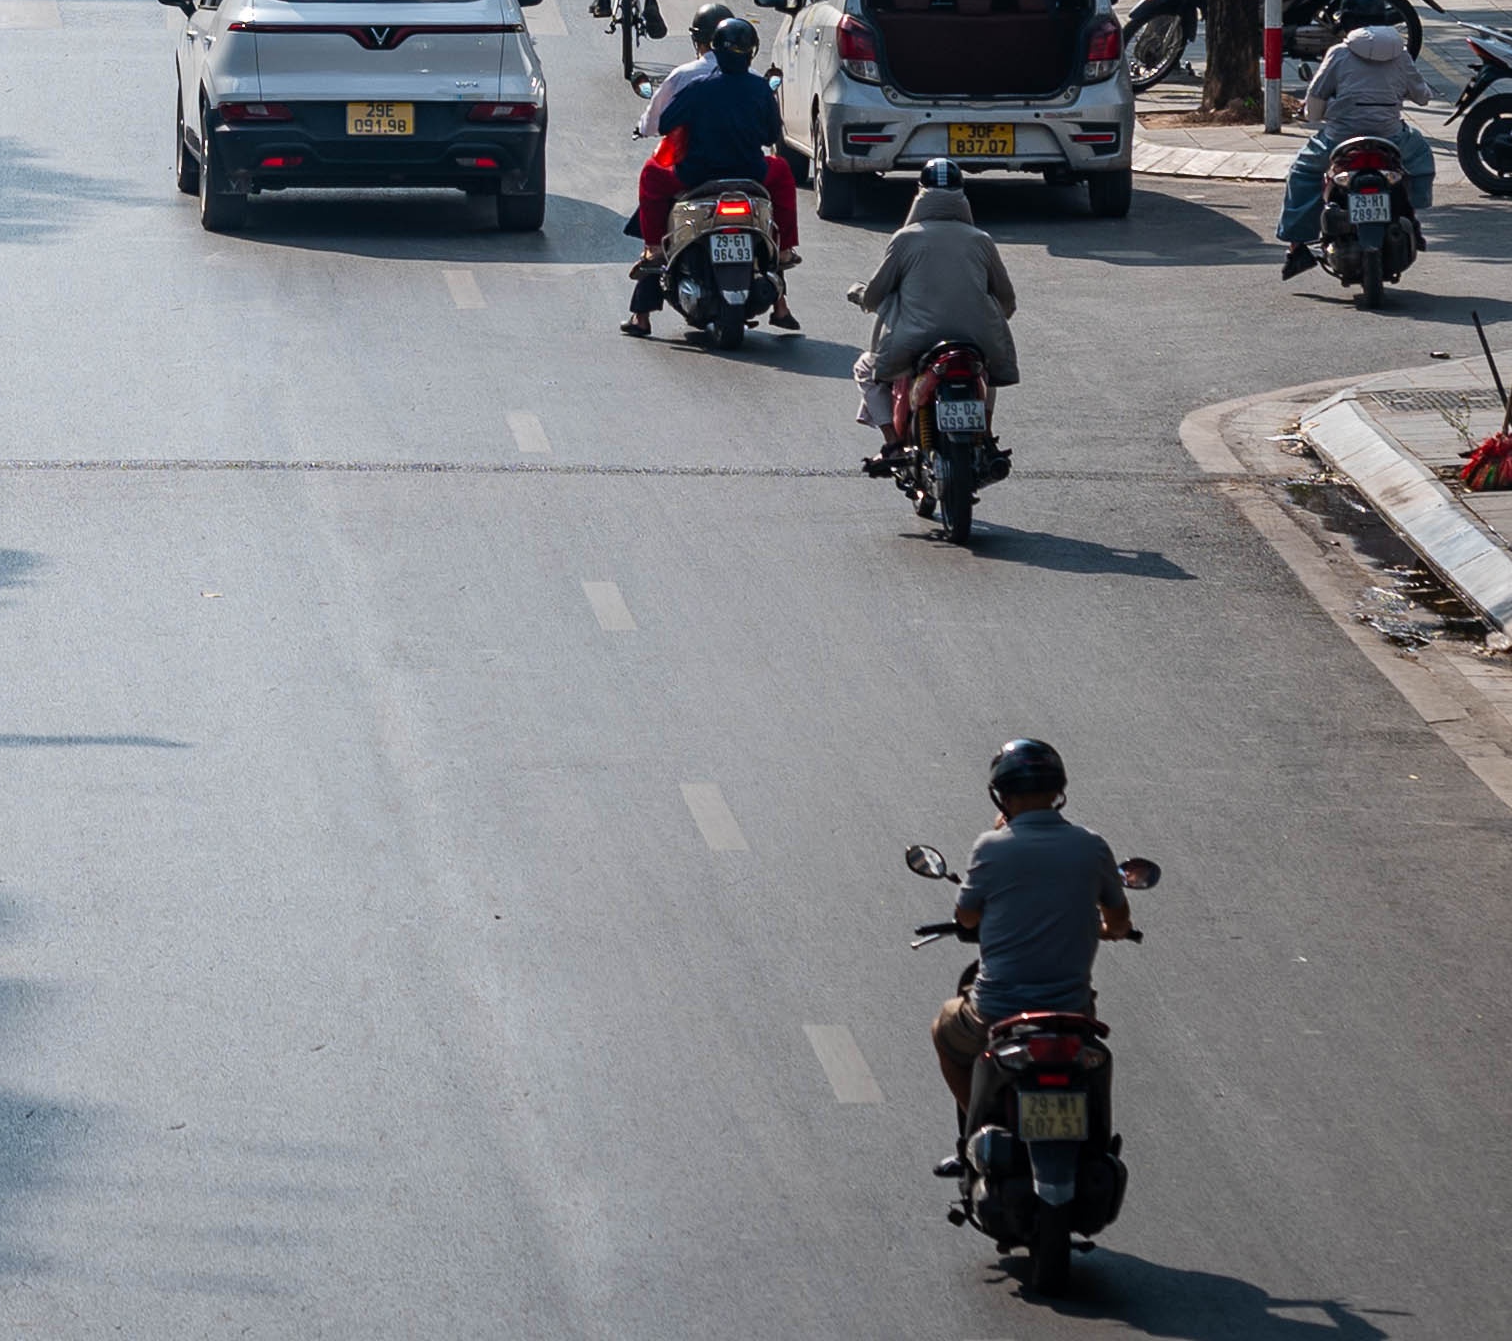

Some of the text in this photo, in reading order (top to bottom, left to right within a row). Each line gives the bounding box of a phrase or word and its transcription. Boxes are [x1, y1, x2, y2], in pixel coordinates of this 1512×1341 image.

[366, 104, 395, 117] 29E
[354, 118, 407, 133] 091.98
[967, 125, 995, 138] 30F
[956, 139, 1007, 153] 837.07
[1355, 195, 1385, 208] 29-H1
[713, 248, 751, 261] 964.93
